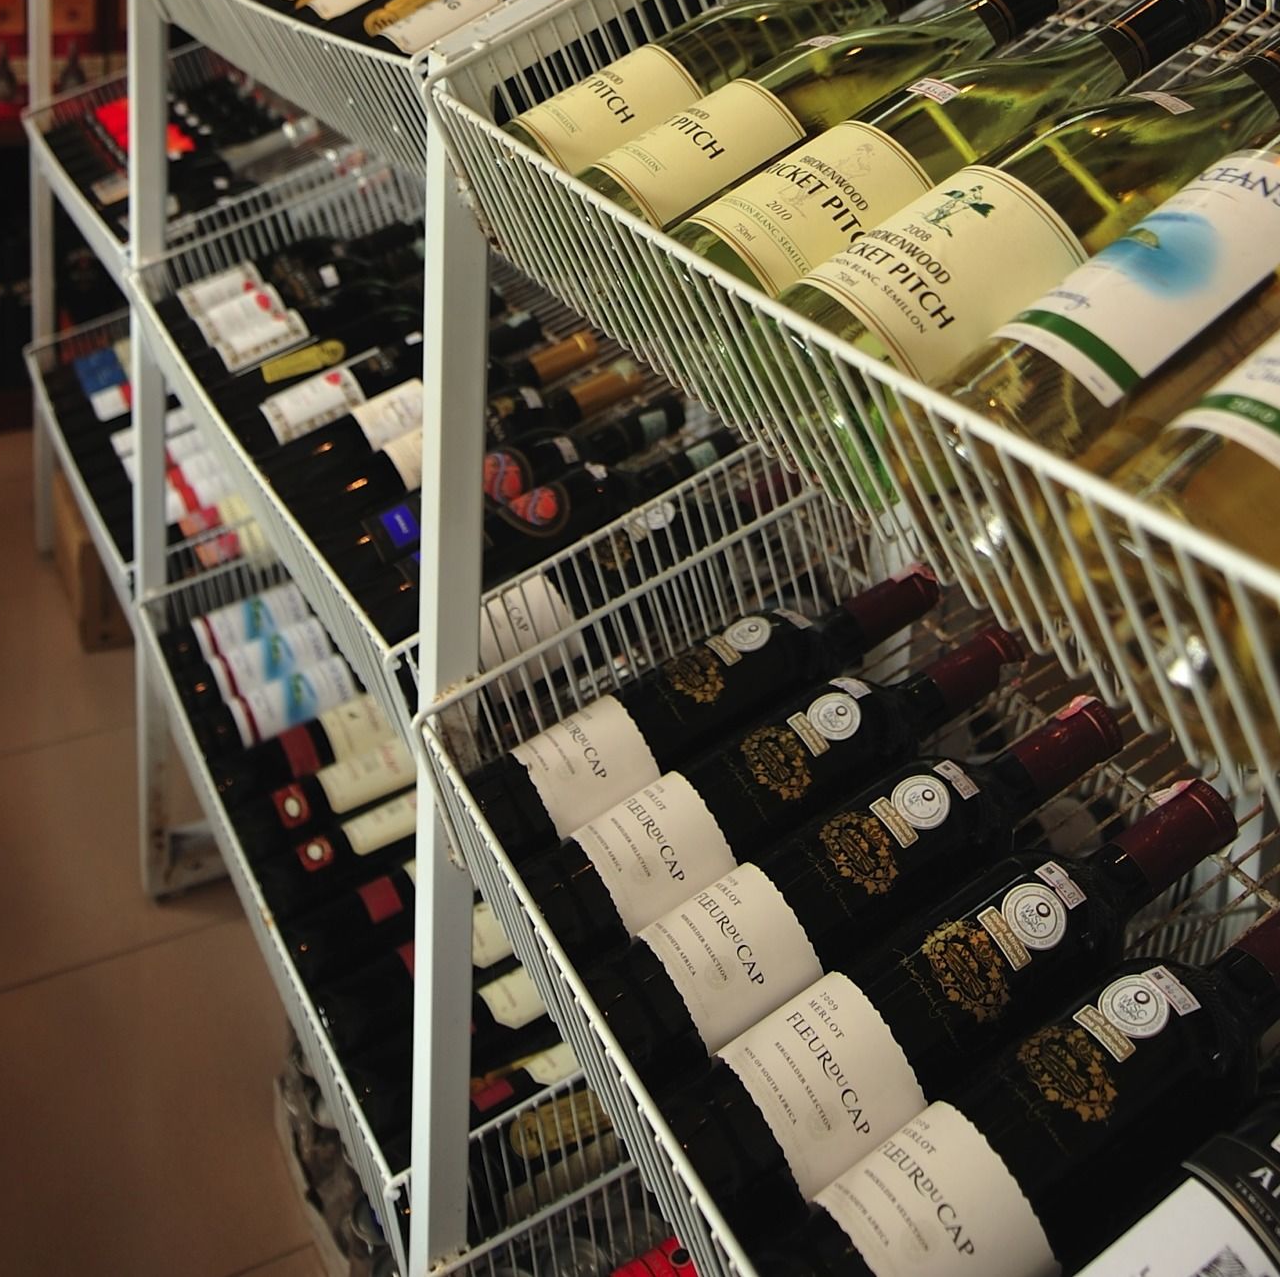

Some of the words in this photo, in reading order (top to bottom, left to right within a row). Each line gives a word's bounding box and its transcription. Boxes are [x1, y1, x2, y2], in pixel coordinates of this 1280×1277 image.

[587, 79, 636, 125] PITCH
[670, 116, 726, 160] PITCH
[799, 156, 869, 212] BROKENWOOD
[766, 200, 793, 222] 2010
[903, 223, 933, 242] 2008
[881, 284, 927, 335] SEMILLON
[888, 262, 956, 331] PITCH
[808, 999, 845, 1039] MERLOT
[819, 991, 840, 1012] 2009
[761, 1068, 779, 1094] SOUTH
[777, 1092, 798, 1126] AFRICA
[804, 1084, 832, 1132] SELECTION
